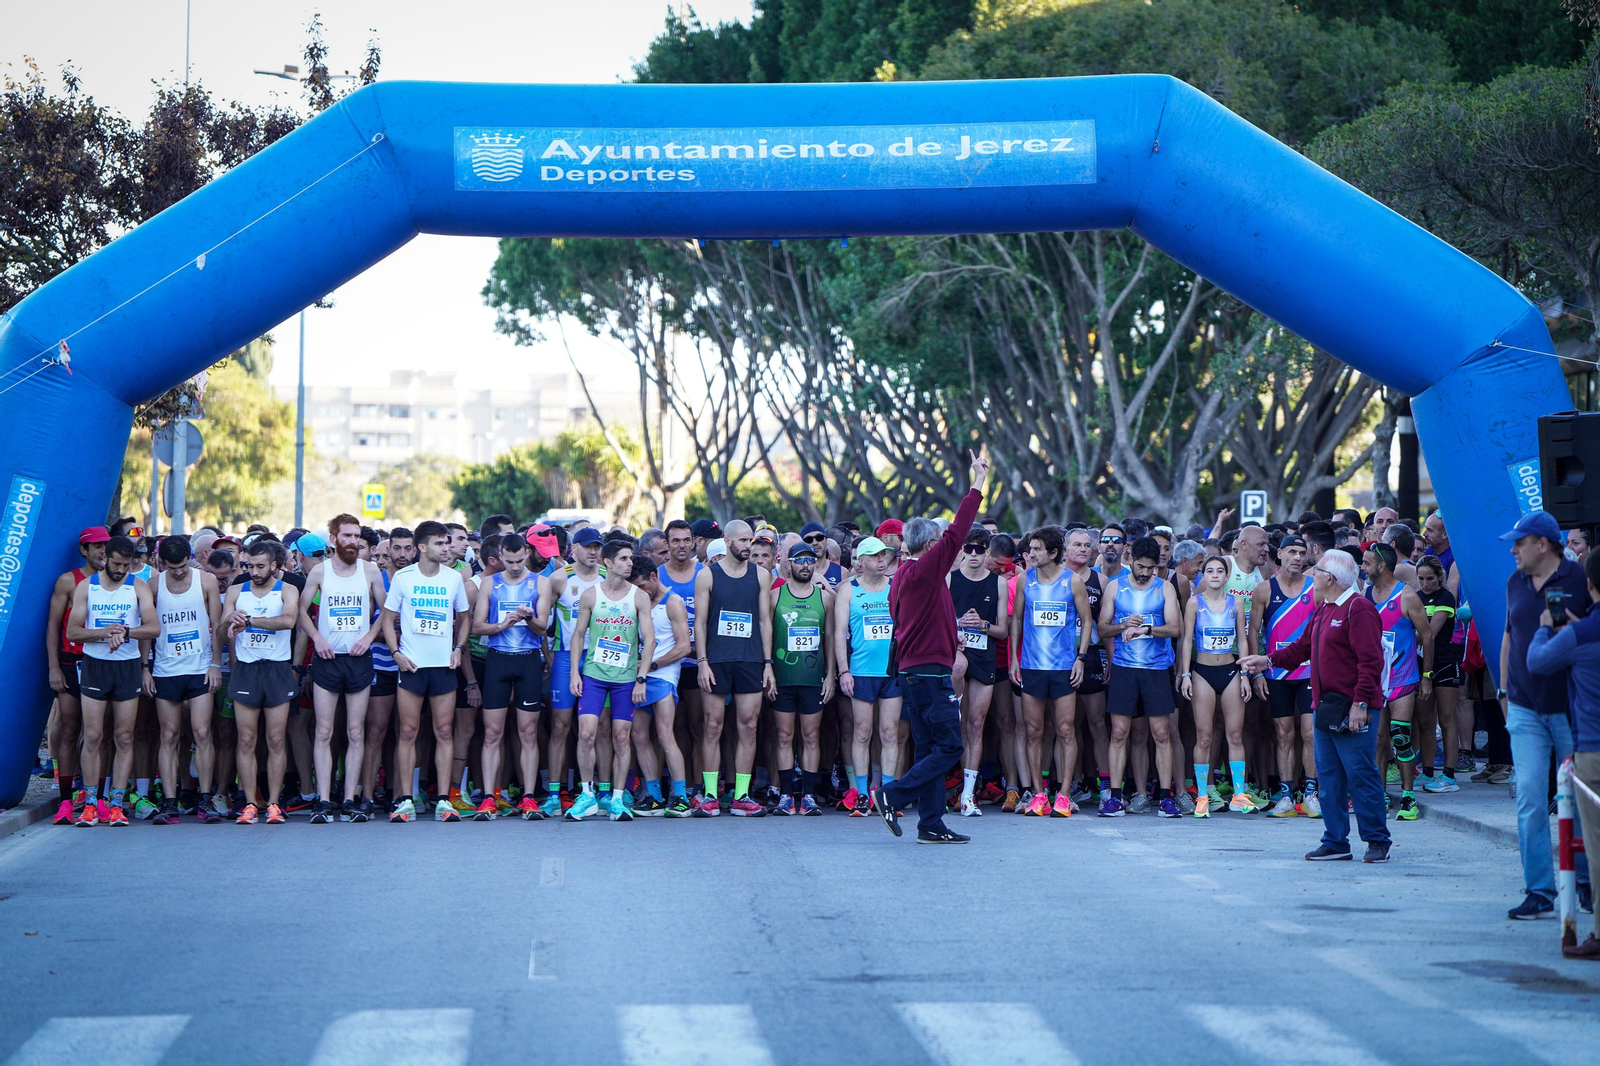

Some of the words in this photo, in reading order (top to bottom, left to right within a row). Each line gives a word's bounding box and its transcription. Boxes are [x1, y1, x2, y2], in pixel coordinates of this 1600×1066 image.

[540, 138, 875, 165] Ayuntamiento
[888, 136, 942, 157] de
[955, 135, 1075, 160] Jerez
[541, 166, 696, 185] Deportes
[1246, 495, 1262, 516] P
[413, 586, 447, 595] PABLO
[328, 595, 363, 606] CHAPIN
[410, 598, 450, 608] SONRIE
[161, 610, 197, 625] CHAPIN
[336, 616, 356, 626] 818
[1040, 611, 1059, 621] 405
[420, 619, 439, 630] 813
[726, 621, 745, 632] 518
[871, 625, 890, 635] 615
[250, 633, 269, 643] 907
[795, 637, 813, 646] 821
[1211, 636, 1229, 646] 739
[175, 641, 194, 652] 611
[602, 649, 621, 661] 575
